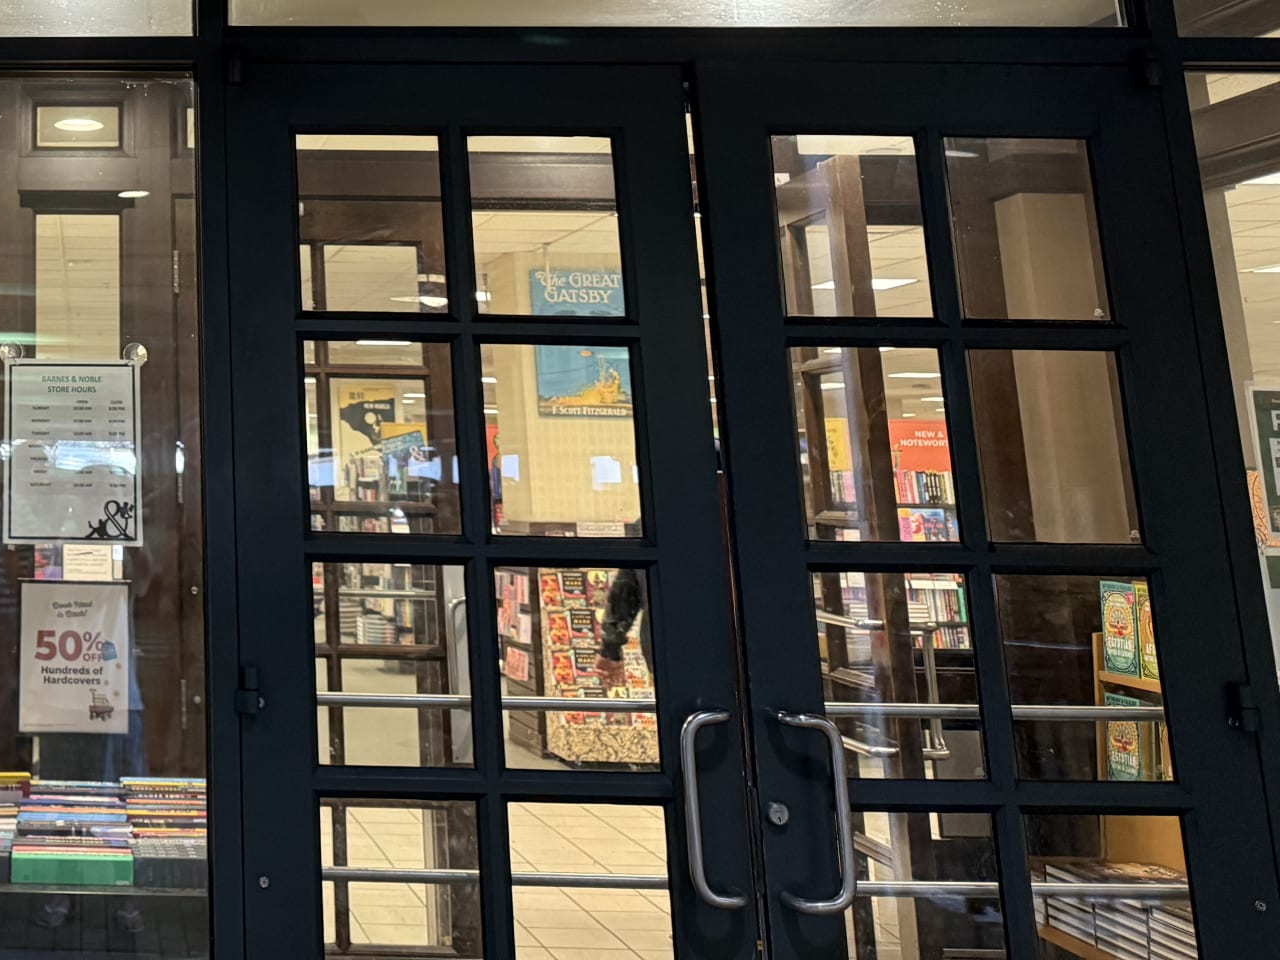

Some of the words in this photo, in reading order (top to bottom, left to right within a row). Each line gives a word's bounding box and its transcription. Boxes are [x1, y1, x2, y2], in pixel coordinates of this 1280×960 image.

[569, 271, 620, 288] GREAT
[544, 287, 613, 304] GATSBY
[34, 630, 103, 662] 50%
[40, 665, 90, 676] Hundreds
[92, 665, 104, 676] of
[43, 675, 101, 686] Hardcovers
